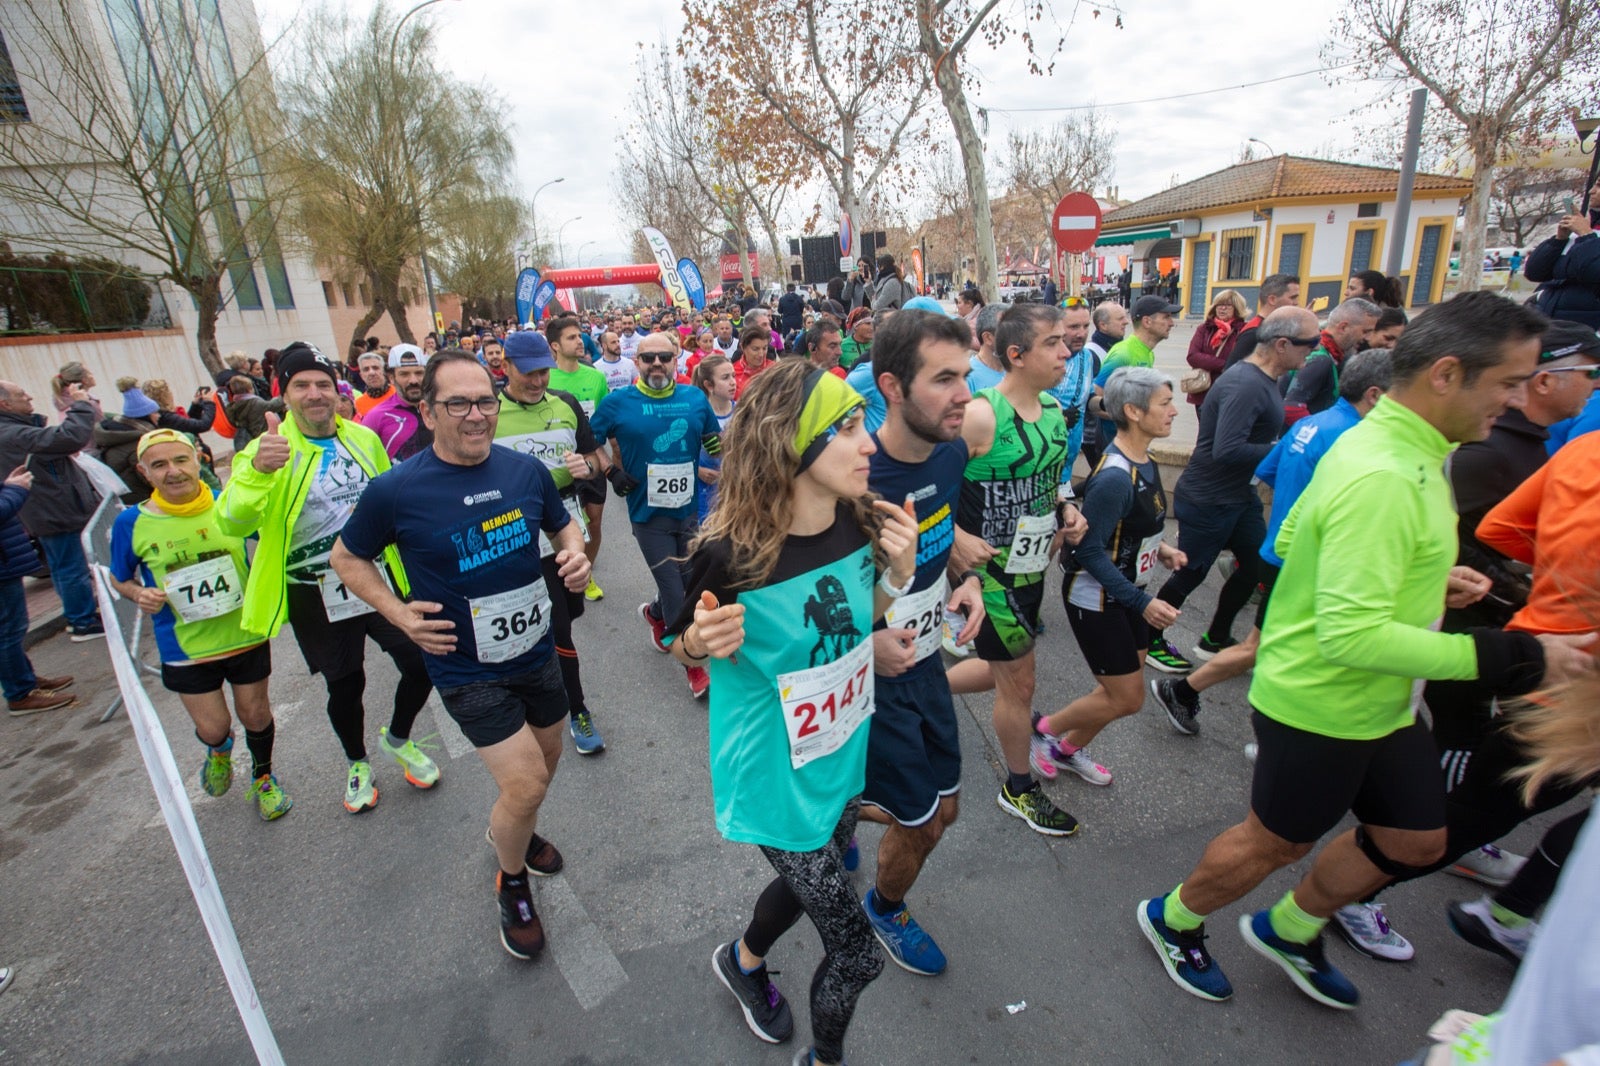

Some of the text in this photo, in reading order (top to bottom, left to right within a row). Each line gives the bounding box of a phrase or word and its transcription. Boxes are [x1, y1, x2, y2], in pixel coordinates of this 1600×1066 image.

[657, 476, 688, 493] 268
[980, 476, 1033, 508] TEAM
[482, 508, 523, 533] MEMORIAL
[983, 506, 1010, 520] MAS
[486, 518, 527, 547] PADRE
[1016, 533, 1054, 557] 317
[459, 532, 531, 573] MARCELINO
[178, 574, 230, 604] 744
[335, 583, 349, 600] 1
[490, 603, 542, 641] 364
[794, 662, 868, 739] 2147
